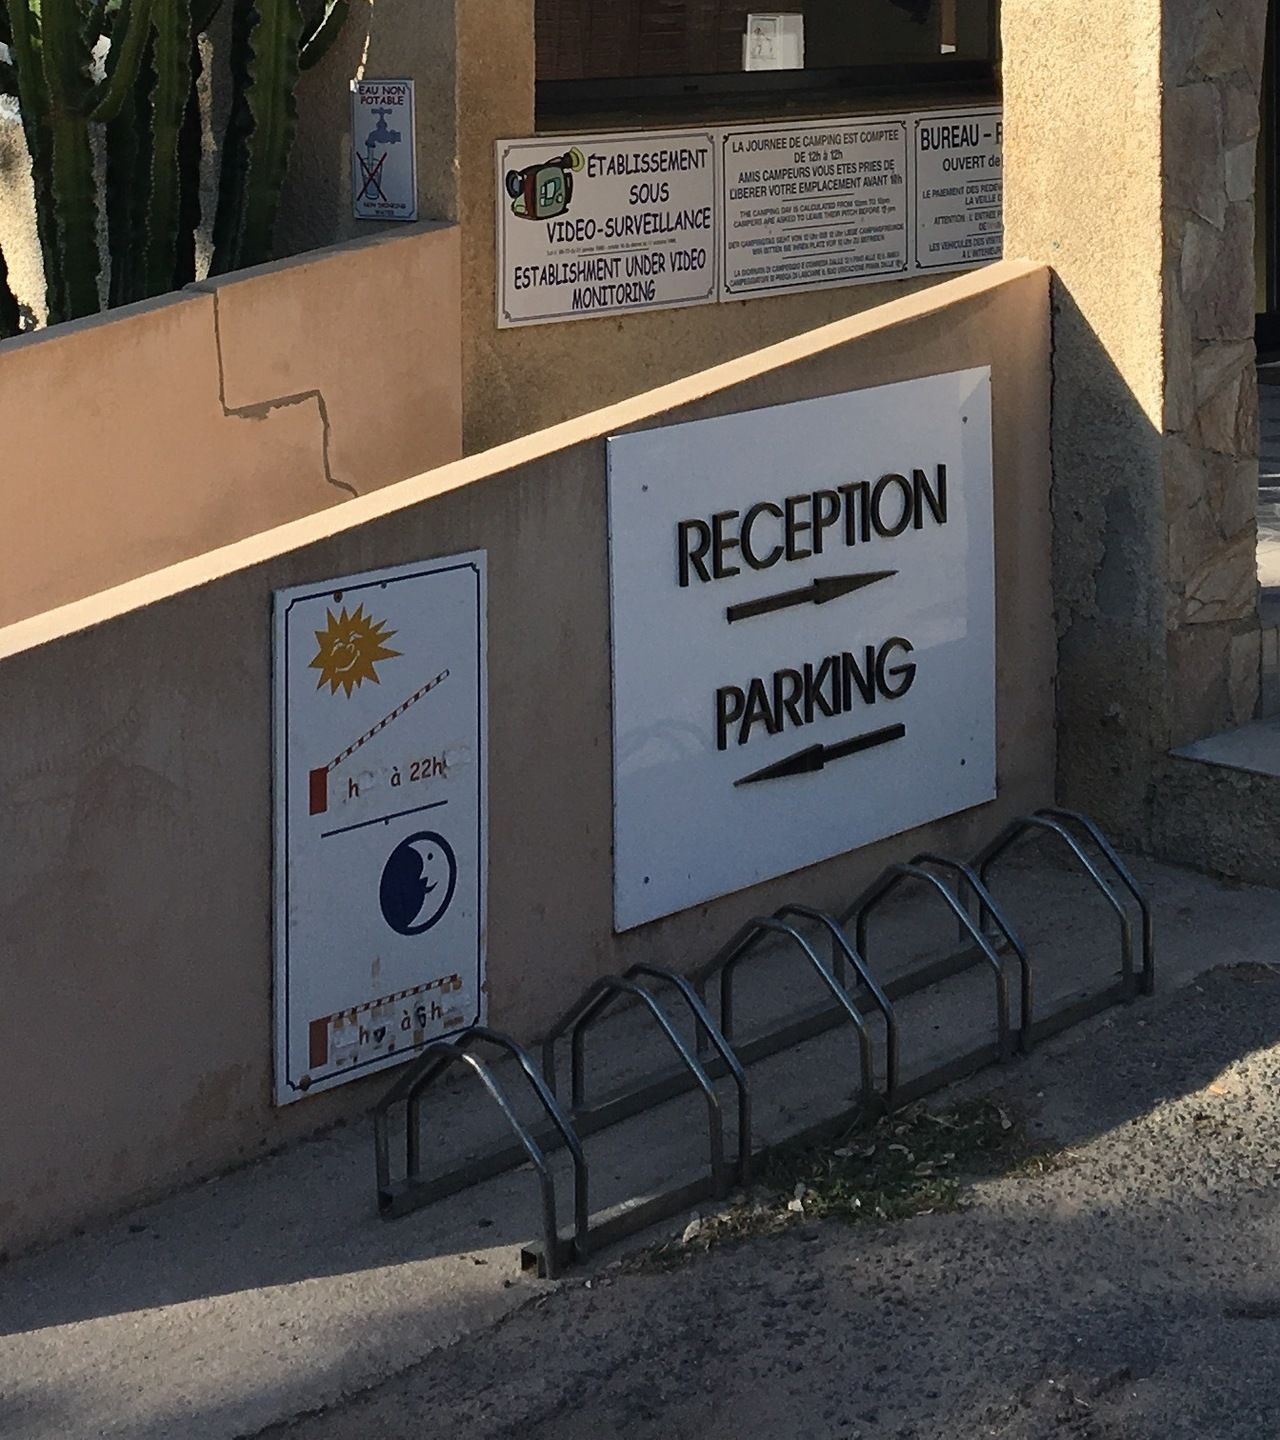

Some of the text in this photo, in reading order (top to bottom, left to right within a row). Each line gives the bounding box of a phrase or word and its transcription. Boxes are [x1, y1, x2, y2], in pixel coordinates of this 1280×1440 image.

[359, 85, 406, 95] EAU NON
[360, 95, 404, 106] POTABLE
[732, 129, 899, 153] LA JOURNEE DE CAMPING EST COMPTEE
[920, 123, 979, 151] BUREAU
[587, 148, 708, 178] ÉTABLISSEMENT
[794, 151, 806, 163] DE
[943, 154, 986, 172] OUVERT
[738, 159, 895, 184] AMIS CAMPEURS VOUS ETES PRIES DE
[629, 182, 670, 205] SOUS
[729, 185, 767, 200] LIBERER
[769, 182, 797, 196] VOTRE
[799, 177, 862, 194] EMPLACEMENT
[863, 175, 887, 187] AVANT
[922, 189, 931, 199] LE
[966, 185, 980, 195] DES
[965, 196, 973, 205] LA
[547, 207, 711, 243] VIDEO-SURVEILLANCE
[514, 257, 622, 290] ESTABLISHMENT
[625, 252, 666, 277] UNDER
[670, 247, 707, 272] VIDEO
[572, 279, 656, 310] MONITORING
[677, 463, 948, 588] RECEPTION
[715, 636, 917, 751] PARKING
[390, 766, 401, 787] à
